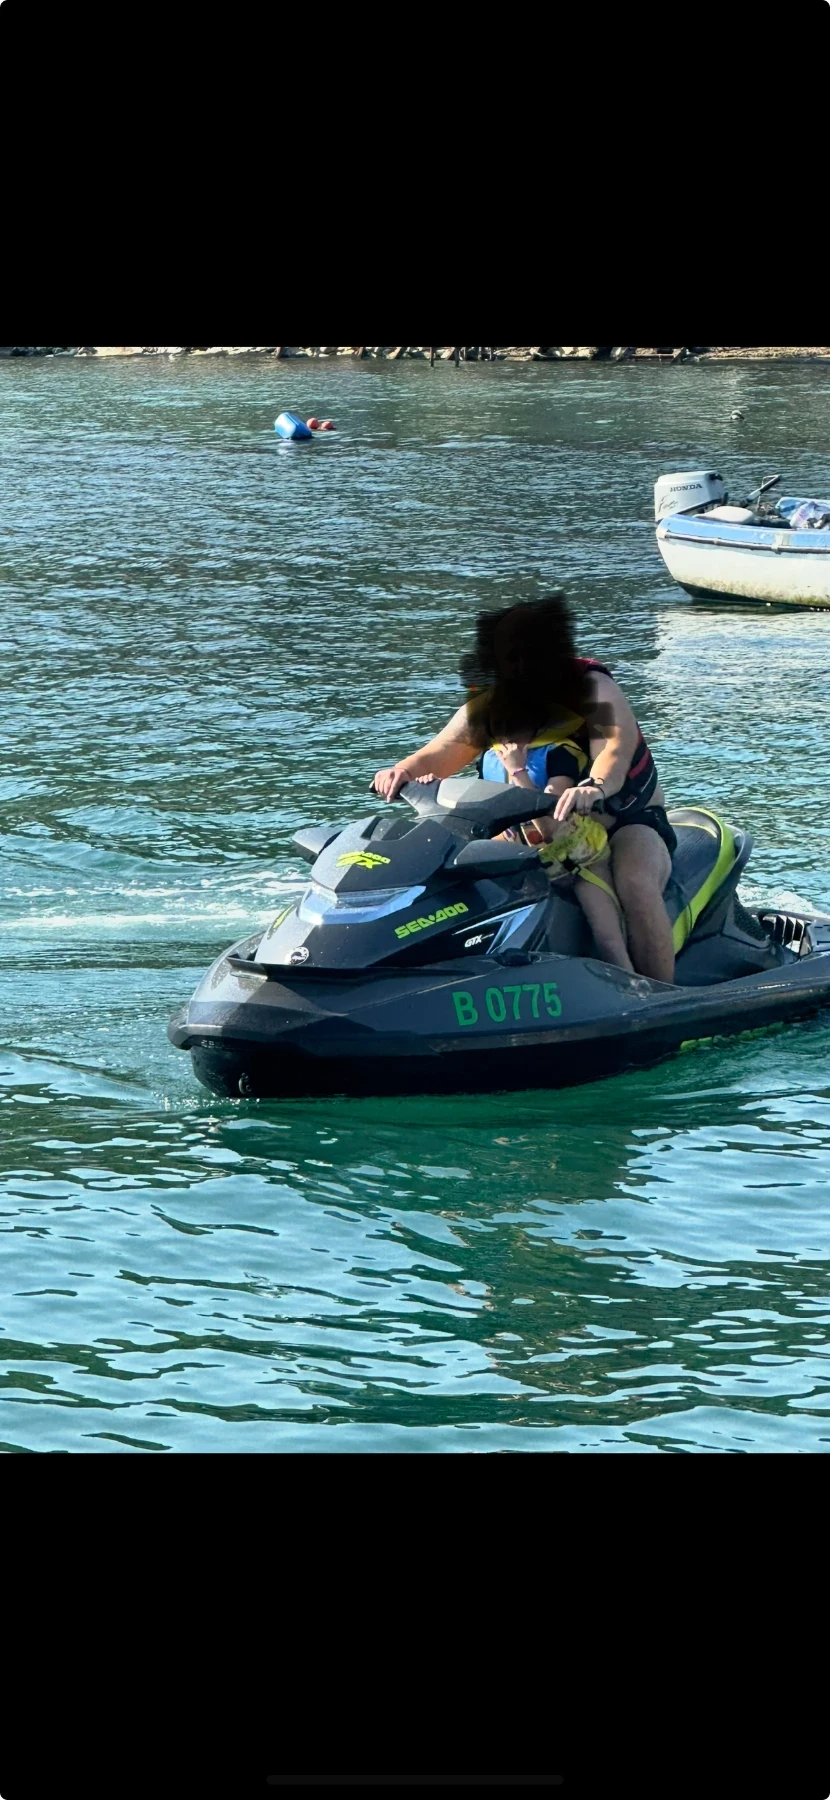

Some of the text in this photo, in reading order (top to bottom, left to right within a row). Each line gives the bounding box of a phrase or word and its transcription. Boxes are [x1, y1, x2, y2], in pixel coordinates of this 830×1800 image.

[669, 483, 703, 493] HONDA
[464, 934, 483, 948] GTX
[452, 982, 562, 1027] B 0775
